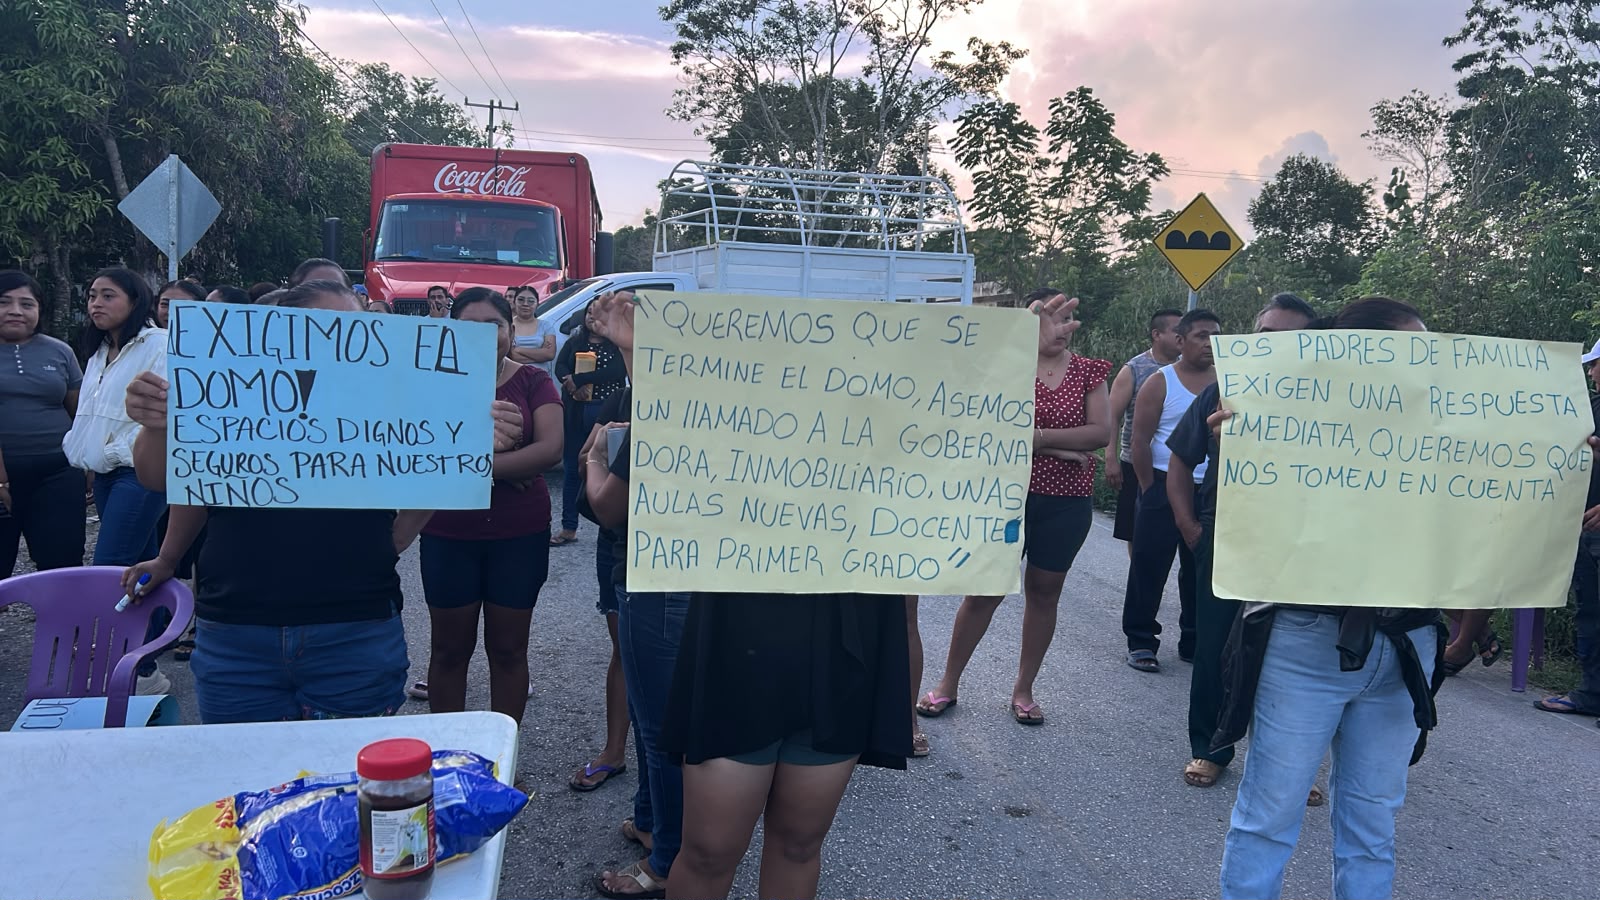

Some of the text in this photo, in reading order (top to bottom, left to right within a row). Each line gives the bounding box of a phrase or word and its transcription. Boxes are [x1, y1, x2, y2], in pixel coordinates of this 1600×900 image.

[434, 163, 531, 196] Coca-Cola
[853, 311, 919, 346] QUE
[941, 316, 980, 346] SE
[1214, 333, 1549, 371] LOS PADRES DE FAMILIA
[174, 367, 317, 419] DOMO!
[639, 346, 1033, 428] TERMINE EL DOMO, ASEMOS
[1350, 382, 1403, 413] UNA
[1429, 385, 1578, 419] RESPUESTA
[174, 414, 463, 446] ESPACIOS DIGNOS Y
[637, 400, 670, 421] UN
[807, 411, 826, 445] A
[842, 417, 873, 447] LA
[900, 424, 1028, 466] GOBERNA
[1224, 412, 1589, 482] IMEDIATA, QUEREMOS QUE
[172, 448, 492, 479] SEGUROS PARA NUESTROS
[635, 440, 717, 482] DORA,
[942, 478, 1023, 510] UNAS
[1224, 459, 1555, 501] NOS TOMEN EN CUENTA
[185, 474, 298, 506] NIÑOS
[634, 483, 723, 516] AULAS
[741, 496, 857, 542] NUEVAS,
[634, 531, 699, 571] PARA
[717, 537, 823, 576] PRIMER
